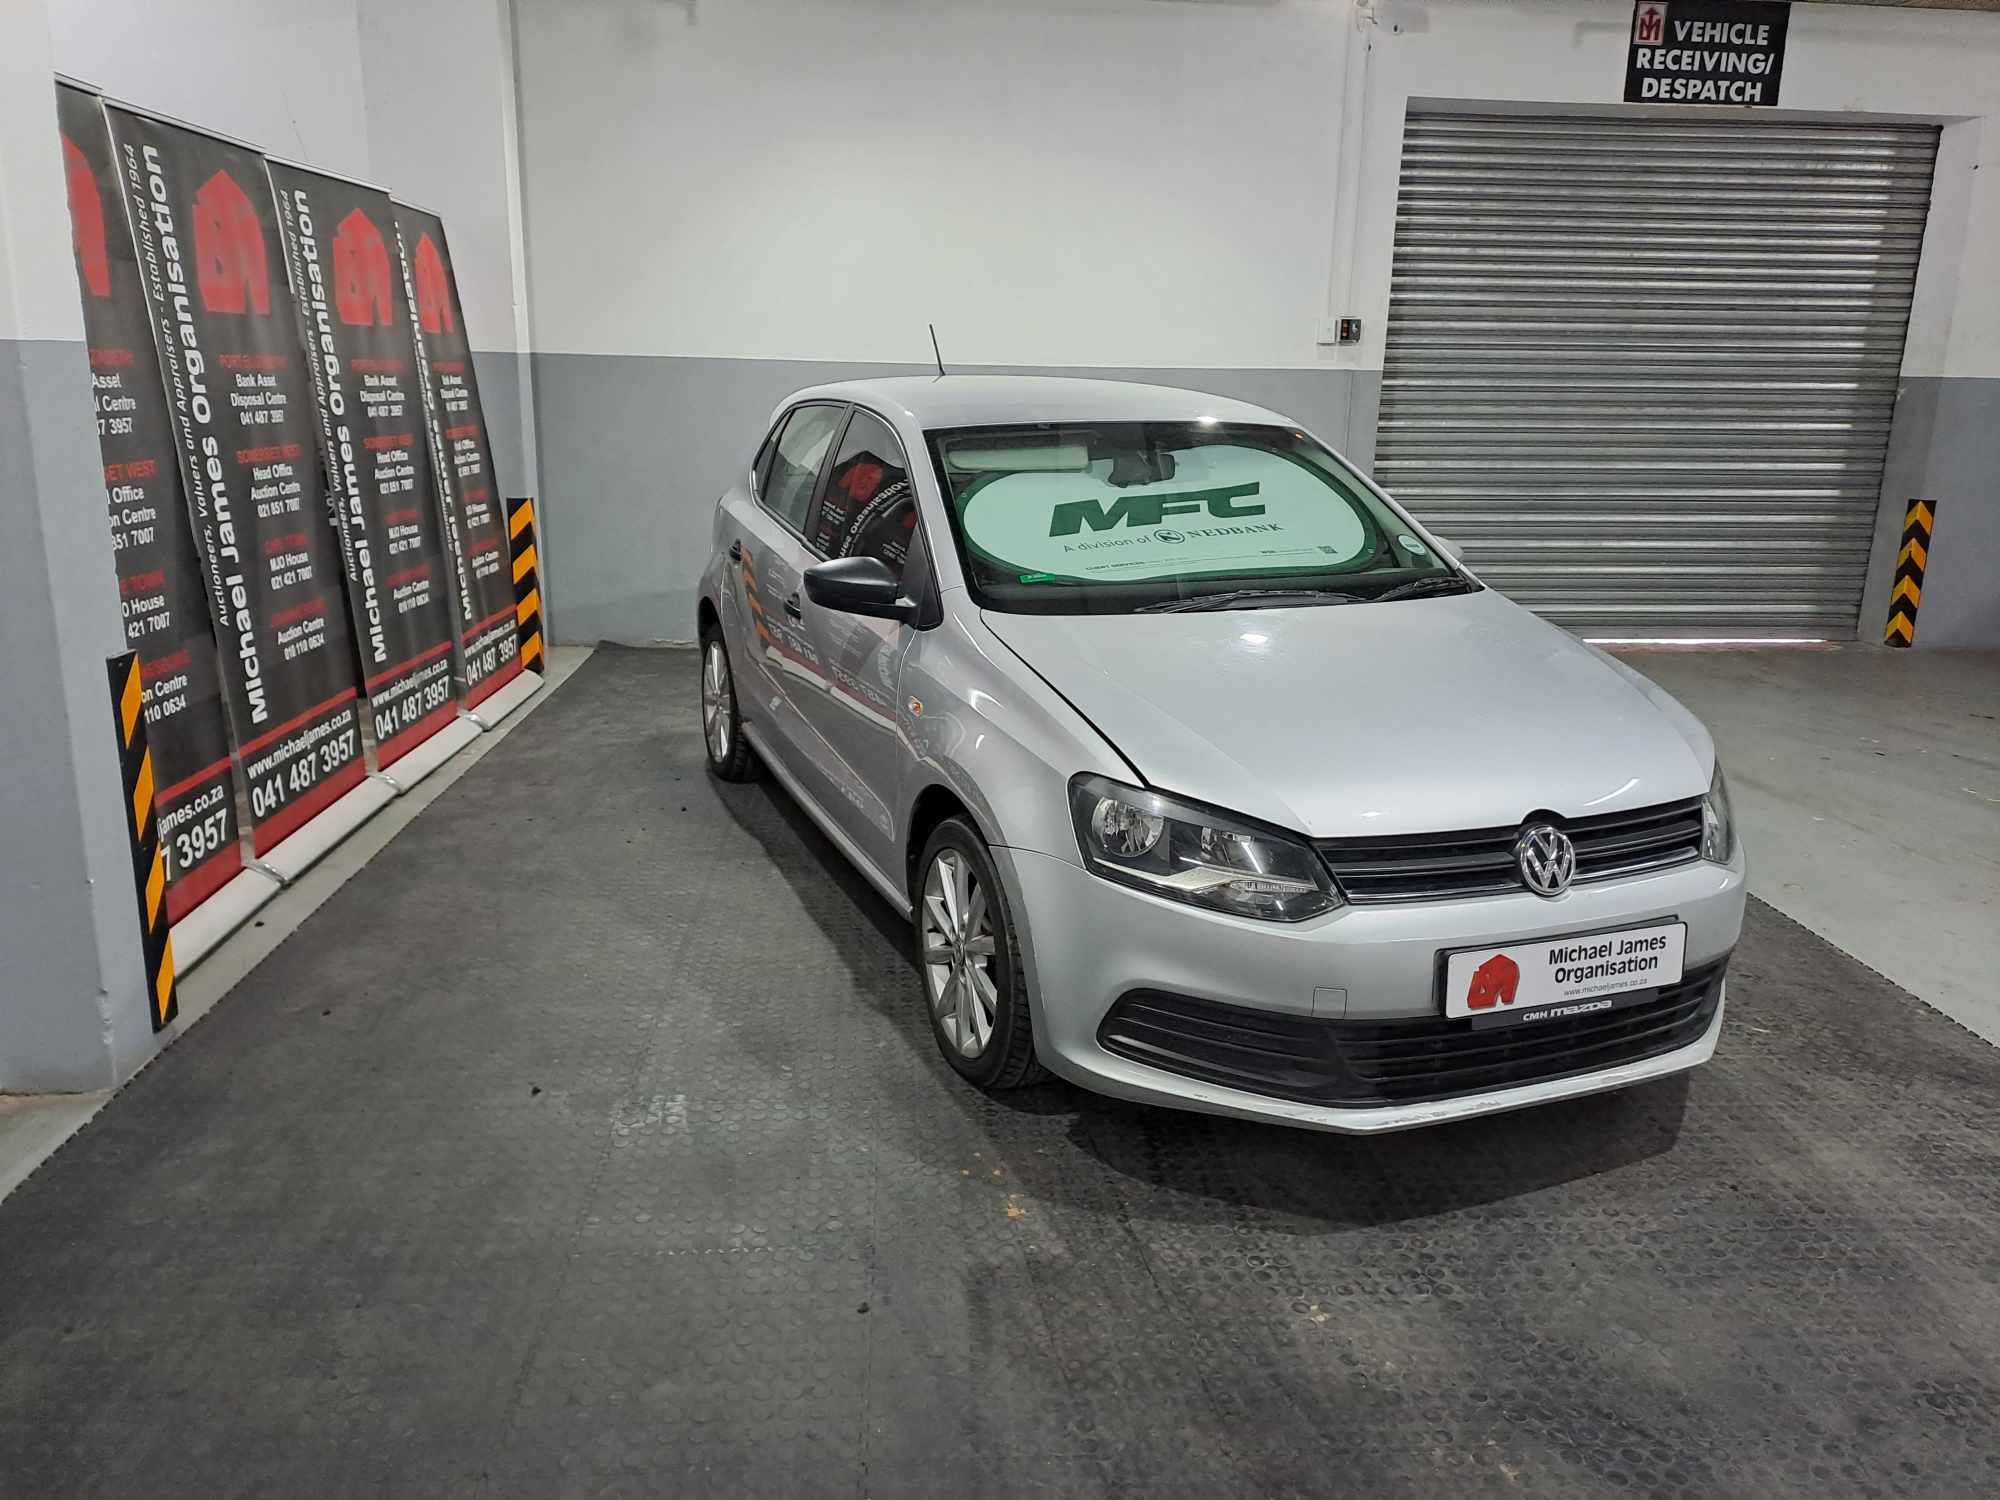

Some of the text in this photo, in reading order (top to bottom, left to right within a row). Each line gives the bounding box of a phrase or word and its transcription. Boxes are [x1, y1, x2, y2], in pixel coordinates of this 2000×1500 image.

[1674, 20, 1770, 46] VEHICLE
[1635, 47, 1775, 75] RECEIVING/
[1641, 77, 1763, 102] DESPATCH
[123, 143, 143, 190] 1964
[132, 194, 165, 301] Established
[161, 317, 188, 412] Appraisers
[102, 395, 137, 411] Centre
[109, 417, 132, 434] 3957
[142, 144, 268, 724] Michael James Organisation
[179, 415, 195, 451] and
[294, 189, 387, 663] Michael James Organisation
[112, 485, 145, 503] Office
[189, 454, 209, 518] Valuers
[250, 485, 278, 501] Auction
[122, 506, 157, 525] Centre
[1049, 481, 1266, 537] MFC
[130, 526, 154, 546] 7007
[1078, 537, 1135, 551] division
[1137, 535, 1151, 545] of
[1187, 522, 1284, 539] NEDBANK
[285, 552, 309, 567] House
[131, 594, 165, 615] House
[127, 611, 171, 640] 421 7007
[277, 625, 303, 645] Auction
[466, 633, 518, 686] 041 487 3957
[155, 673, 188, 697] Centre
[163, 693, 186, 717] 0634
[375, 675, 449, 740] 041 487 3957
[247, 709, 352, 780] www.michaeljames.co.za
[252, 728, 354, 817] 041 487 3957
[176, 808, 227, 868] 3957
[1549, 936, 1667, 965] Michael James
[1554, 955, 1658, 983] Organisation
[1564, 977, 1648, 997] www.michaeljames.co.za
[1523, 1010, 1548, 1022] CMH
